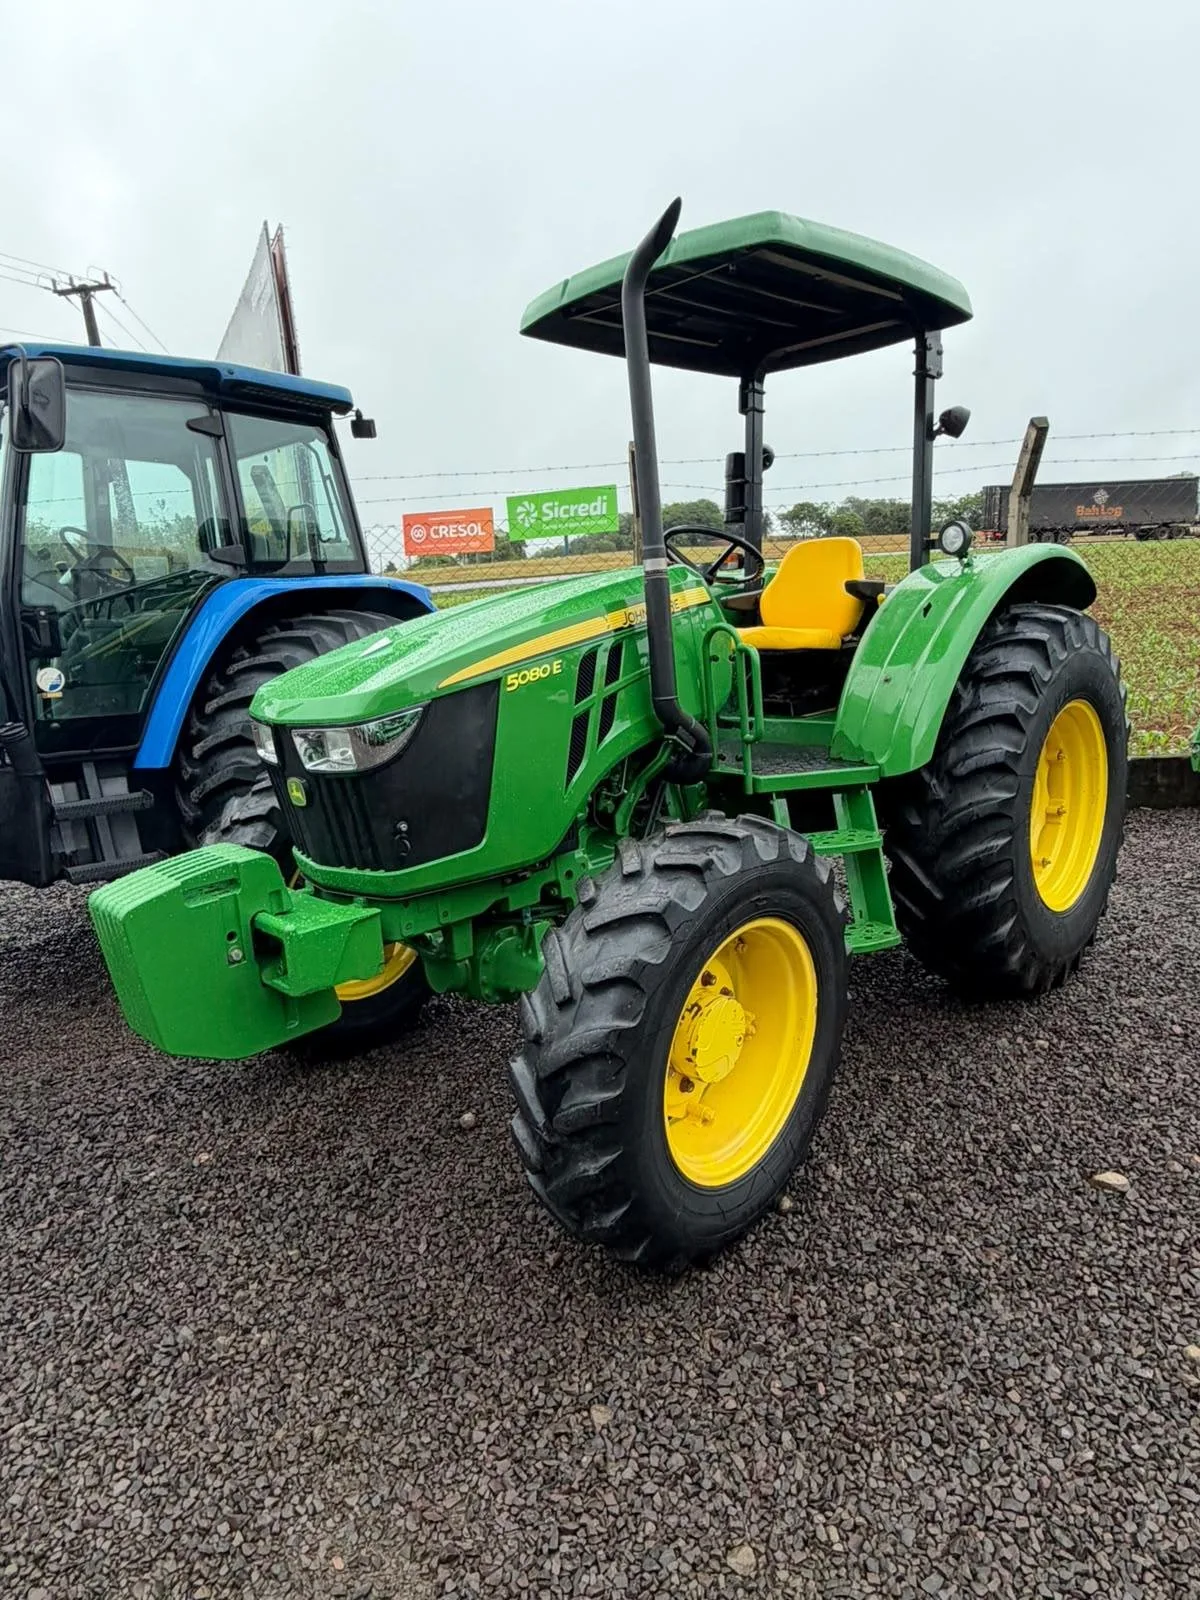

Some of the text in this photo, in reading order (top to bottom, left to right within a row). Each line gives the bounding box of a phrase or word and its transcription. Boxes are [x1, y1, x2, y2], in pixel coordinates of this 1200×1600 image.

[541, 495, 608, 520] Sicredi
[430, 522, 486, 539] CRESOL
[506, 659, 563, 692] 5080 E
